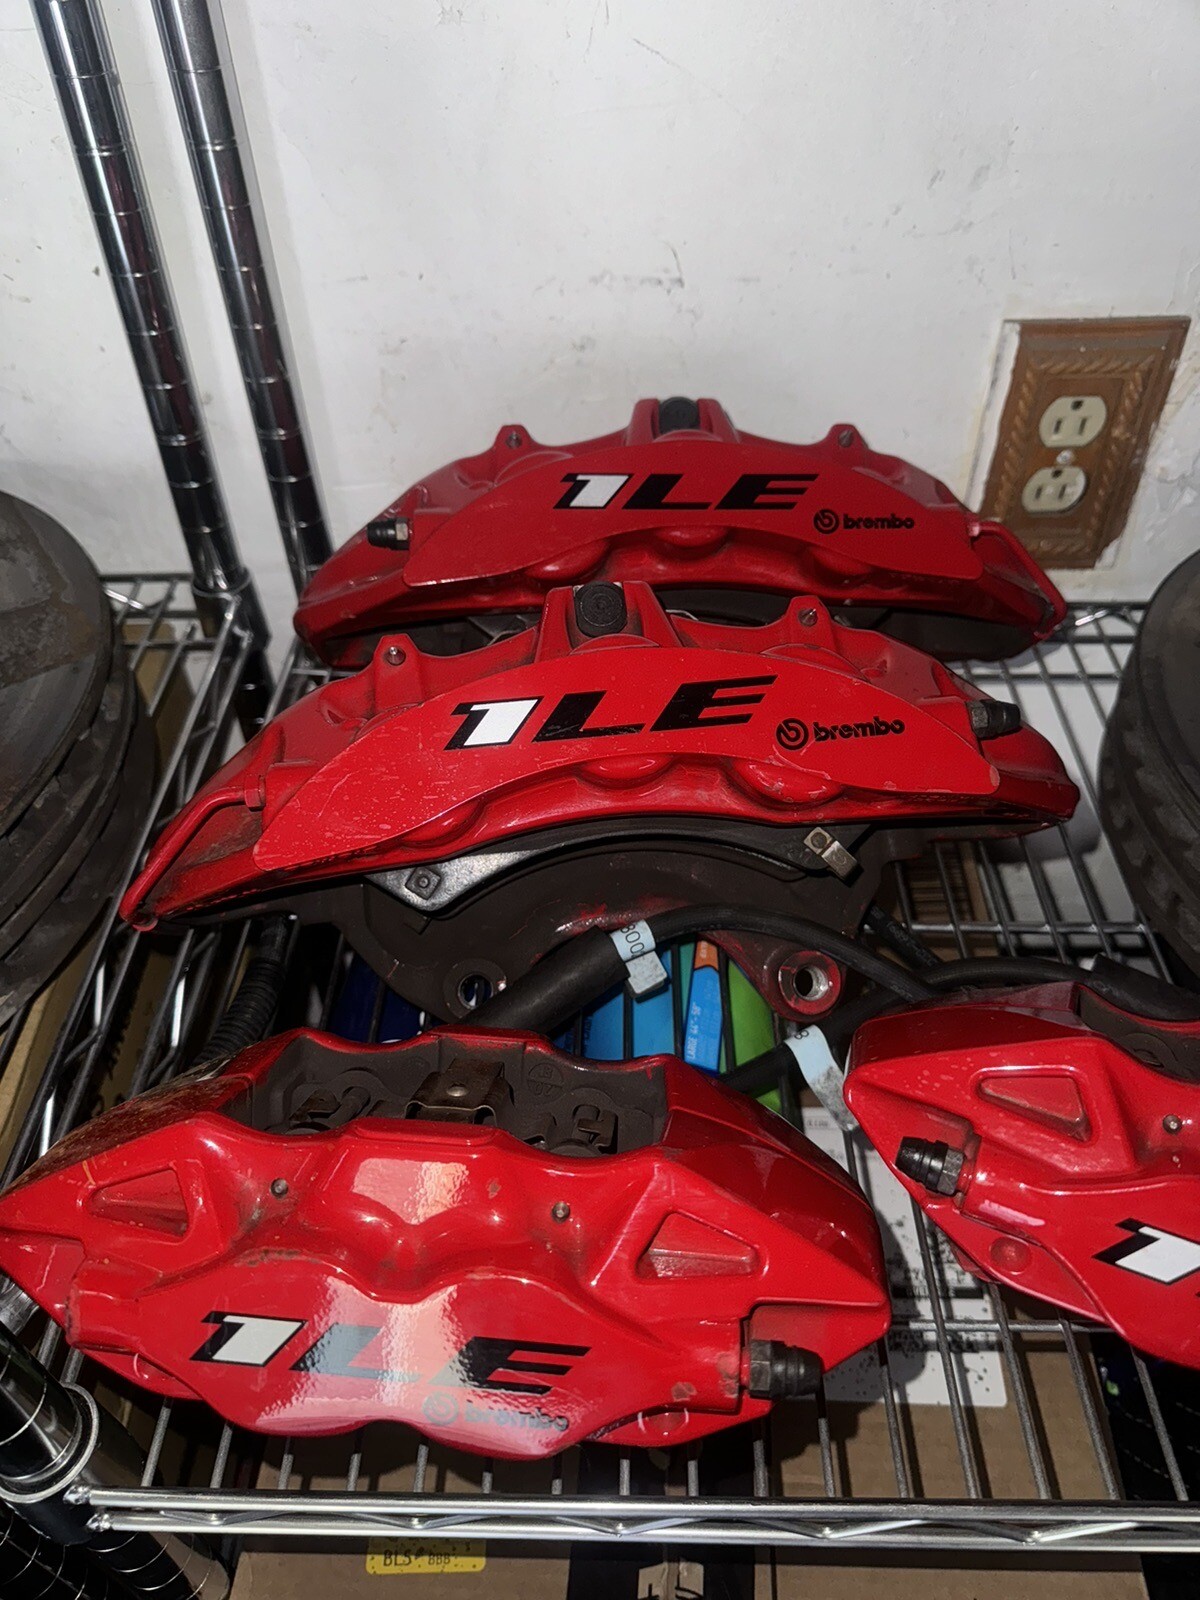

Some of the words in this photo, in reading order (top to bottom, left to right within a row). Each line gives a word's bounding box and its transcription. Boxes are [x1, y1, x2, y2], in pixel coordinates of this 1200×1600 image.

[554, 473, 819, 509] 1LE
[843, 513, 915, 529] brembo
[444, 675, 778, 750] 1LE
[814, 716, 905, 741] brembo
[686, 1037, 699, 1060] LARGE
[189, 1311, 591, 1395] 1LE
[465, 1401, 569, 1431] brembo
